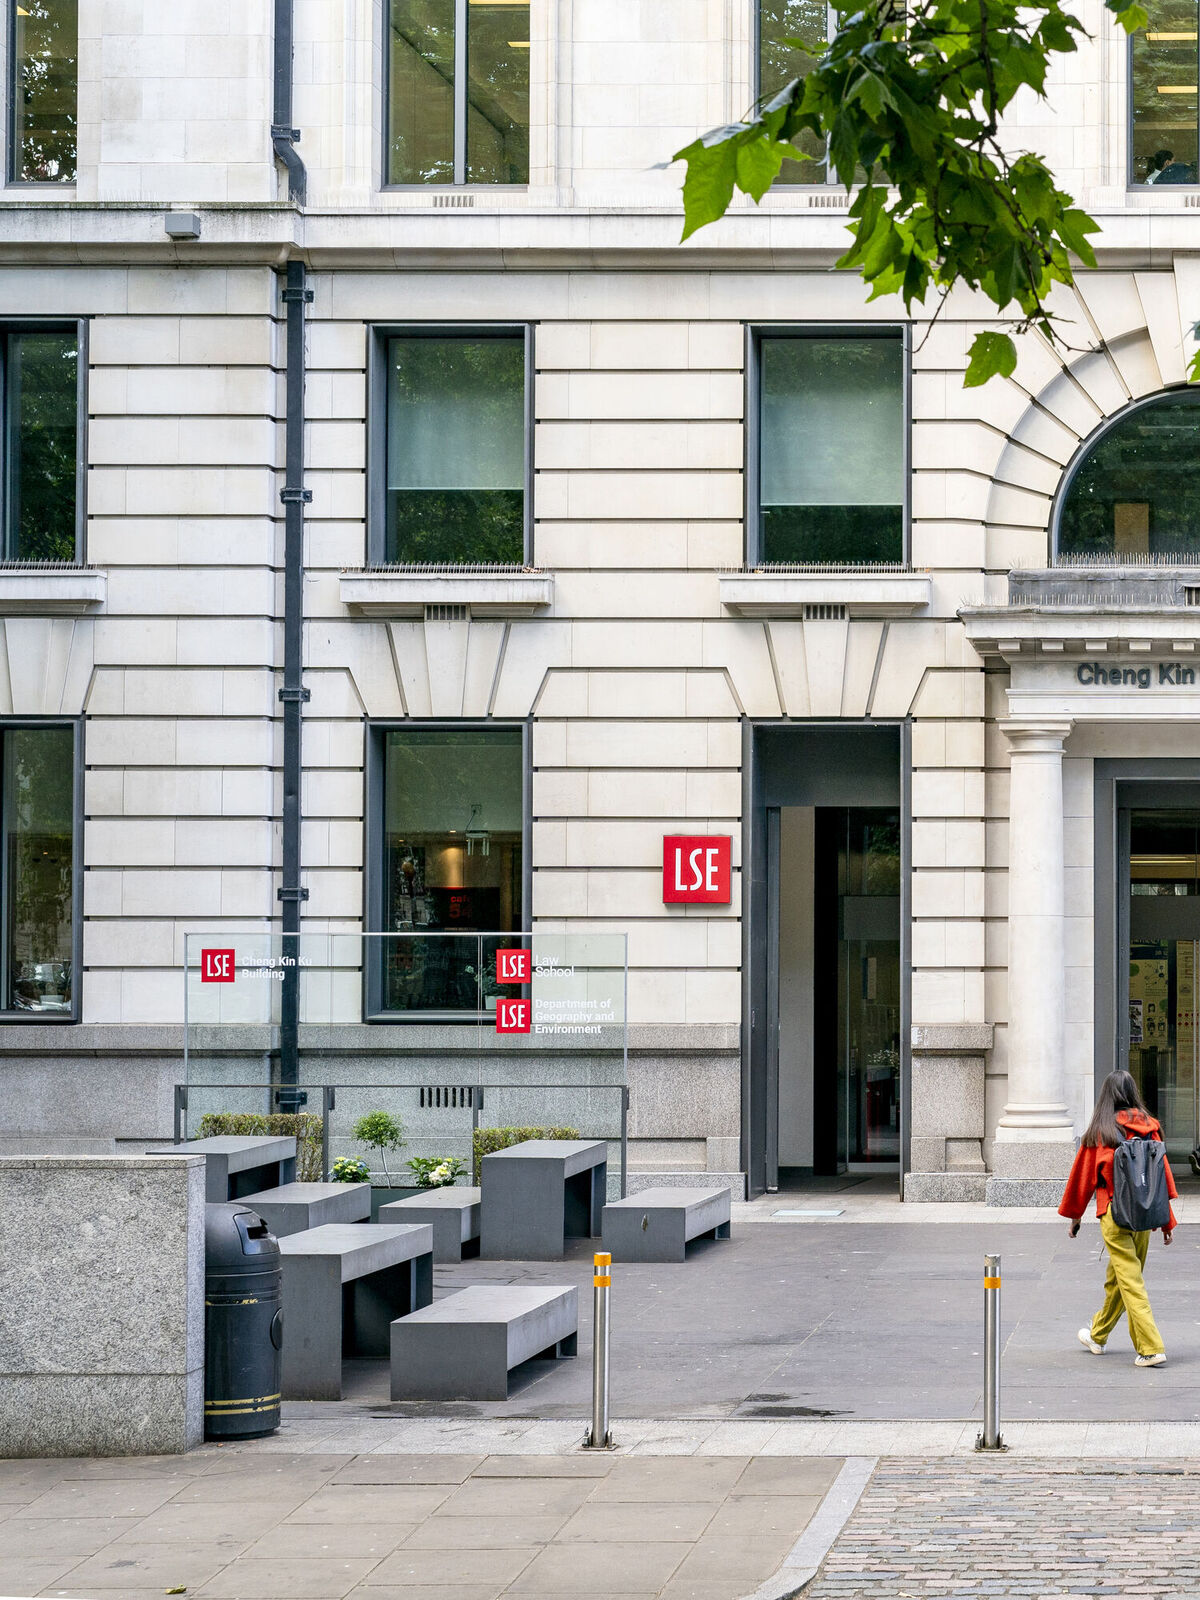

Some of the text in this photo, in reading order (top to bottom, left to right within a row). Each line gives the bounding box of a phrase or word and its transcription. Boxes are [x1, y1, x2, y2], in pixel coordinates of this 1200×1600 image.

[1077, 662, 1151, 689] Cheng
[1158, 662, 1195, 685] Kin
[675, 848, 719, 891] LSE
[207, 954, 230, 977] LSE
[242, 956, 312, 968] Cheng Kin Ku
[502, 955, 525, 978] LSE
[535, 955, 559, 966] Law
[242, 969, 285, 980] Building
[535, 965, 575, 978] School
[535, 998, 611, 1010] Department of
[501, 1004, 525, 1028] LSE
[535, 1011, 615, 1023] Geography and
[535, 1024, 602, 1034] Environment
